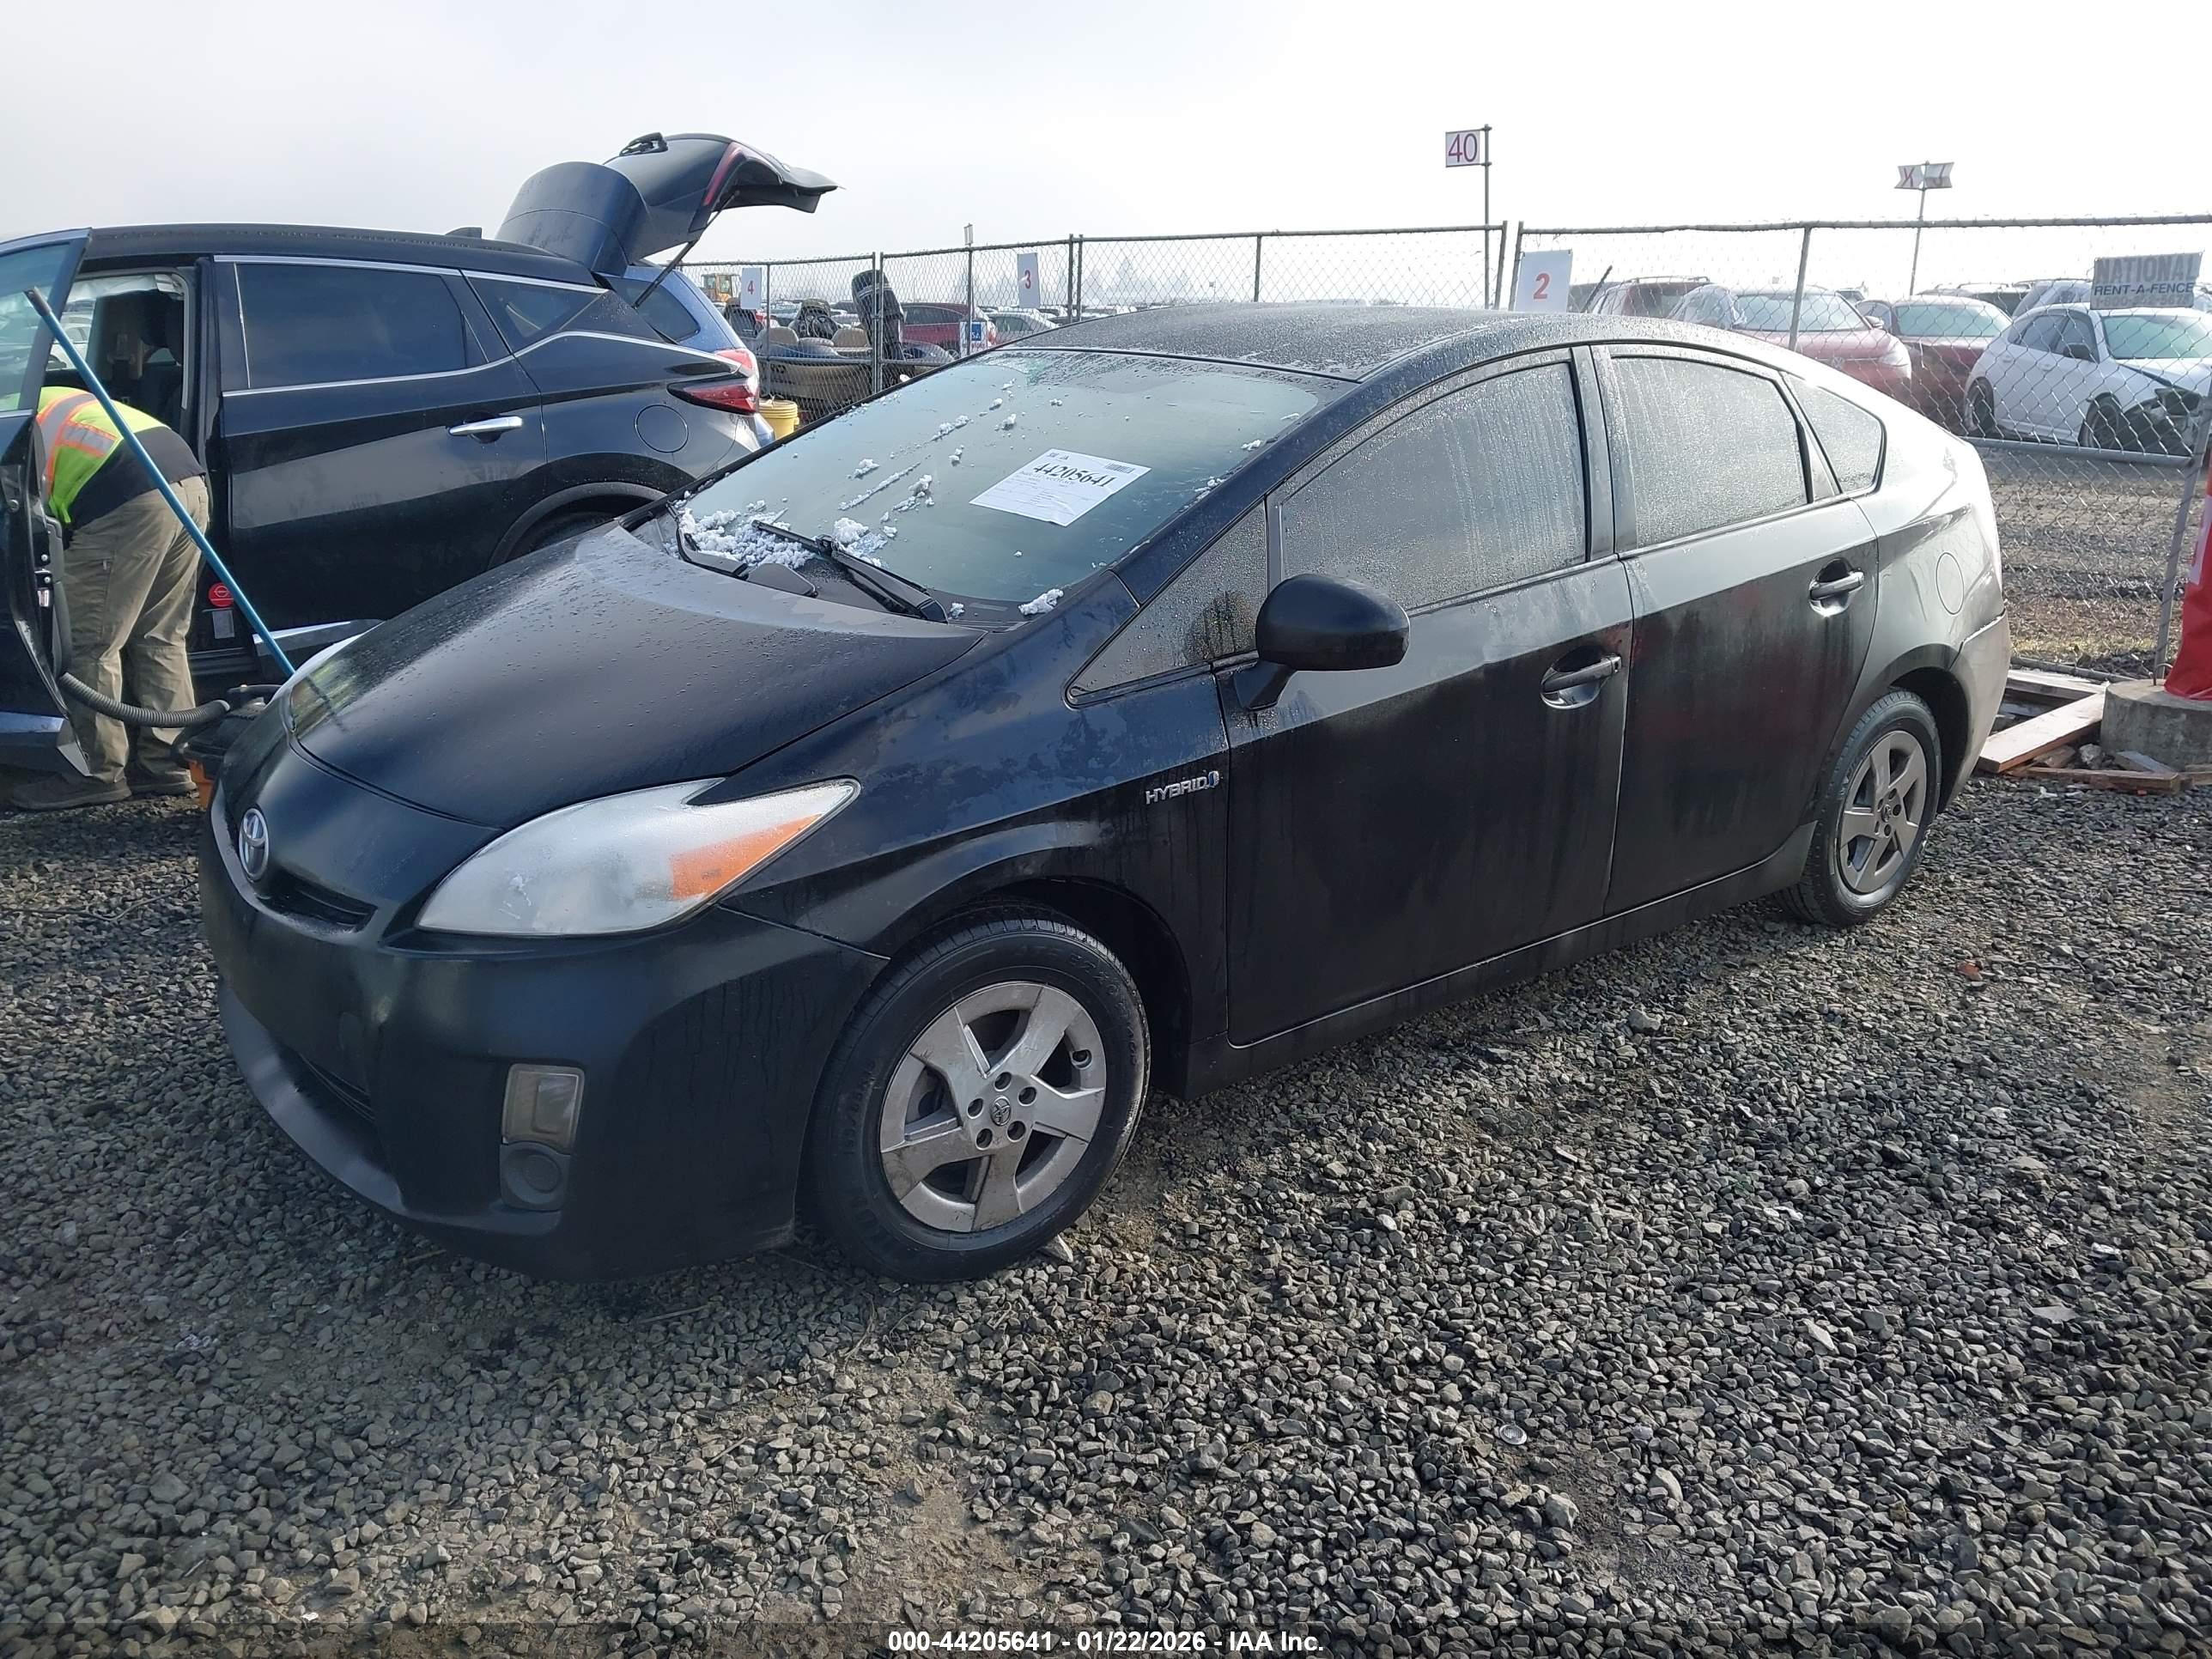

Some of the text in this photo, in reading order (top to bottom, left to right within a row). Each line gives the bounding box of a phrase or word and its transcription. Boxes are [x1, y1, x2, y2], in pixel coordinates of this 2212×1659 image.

[1448, 133, 1478, 163] 40
[1024, 270, 1031, 289] 3
[2096, 253, 2197, 284] NATIONAL
[747, 280, 755, 295] 4
[1533, 272, 1550, 300] 2
[2094, 282, 2196, 296] RENT-A-FENCE
[1033, 462, 1118, 488] 44205641
[1146, 775, 1207, 805] HYBRID
